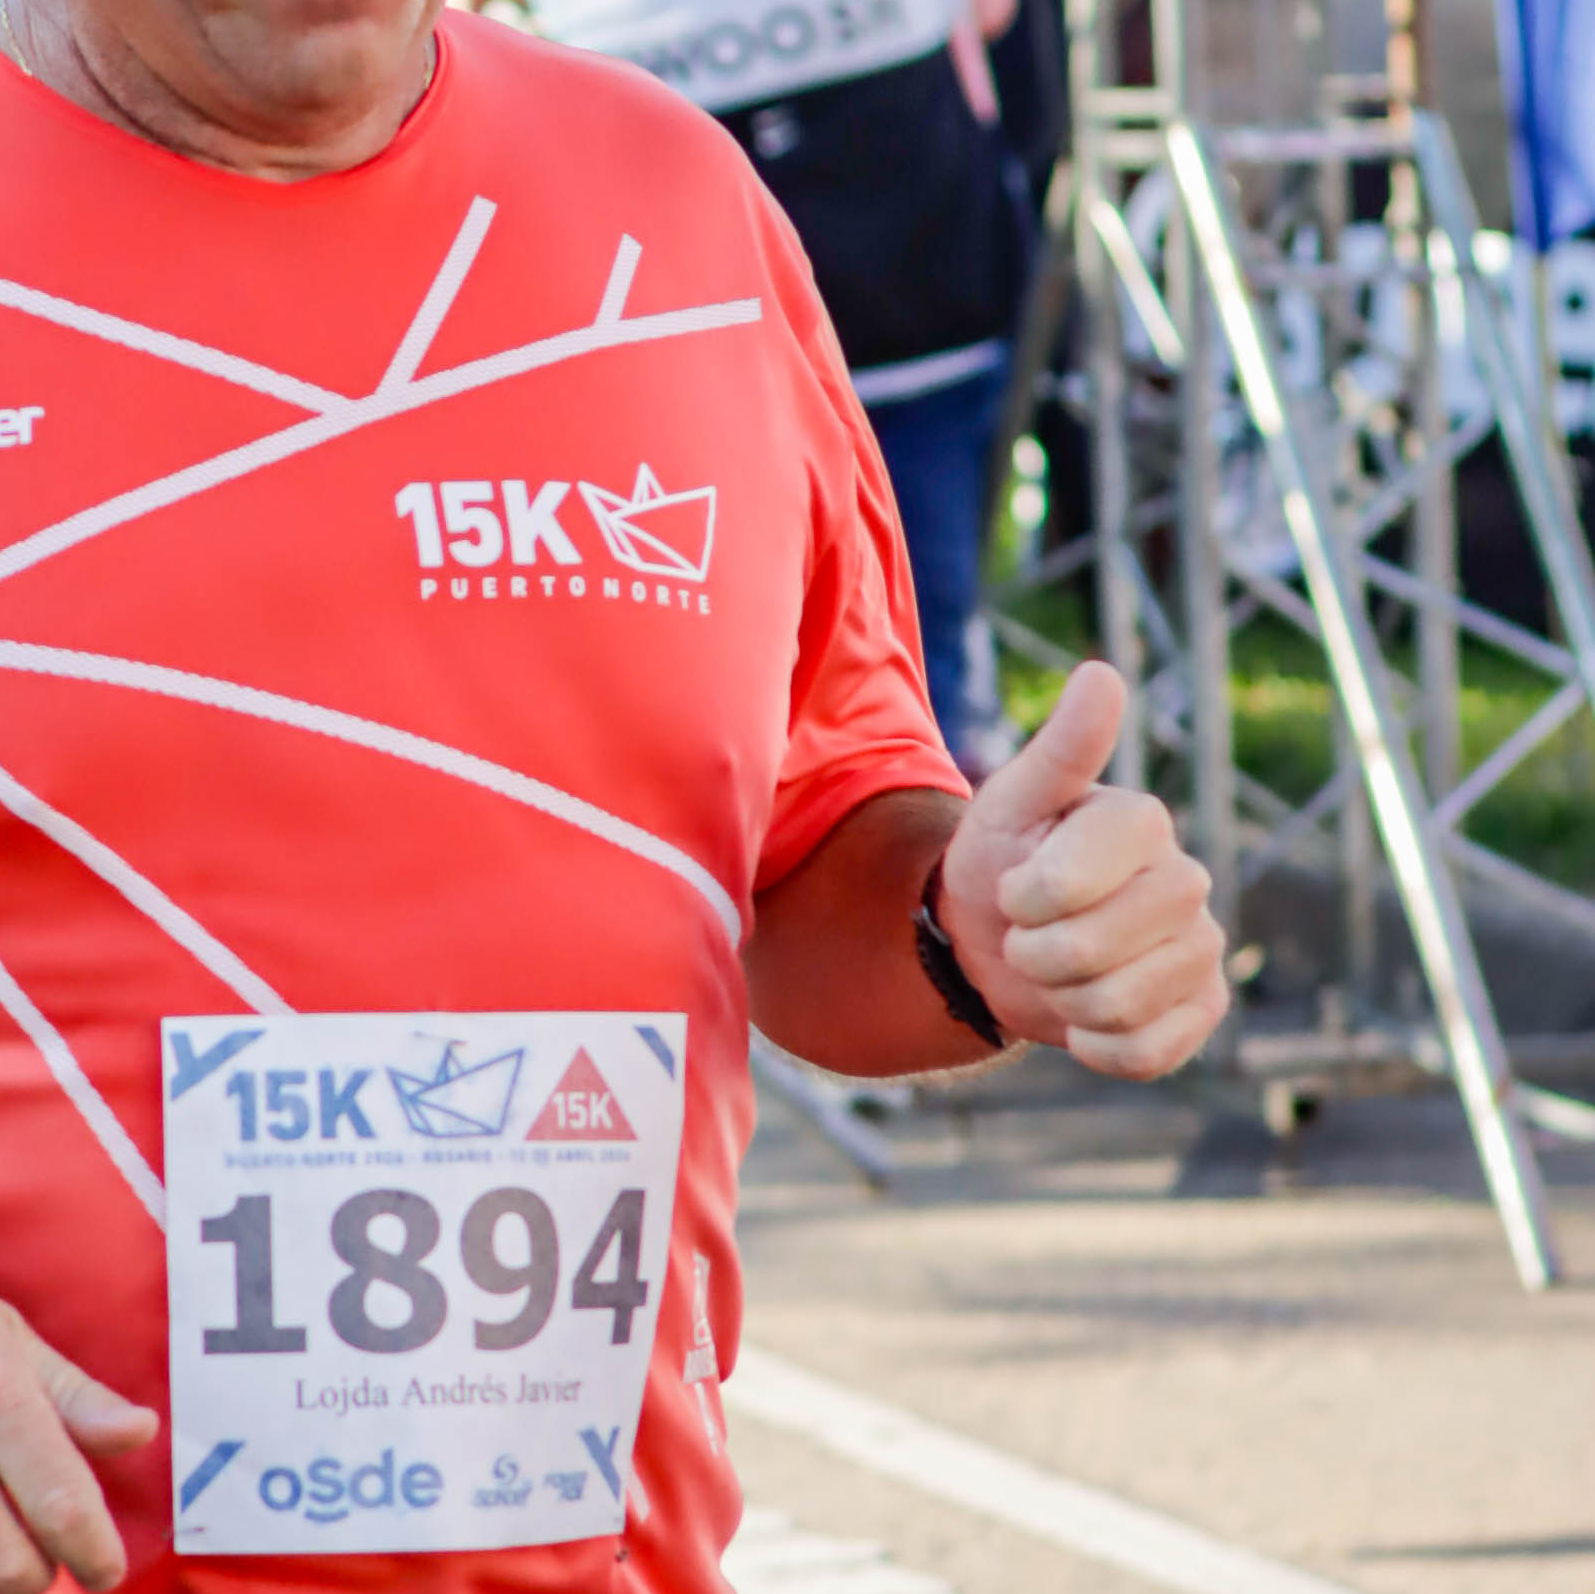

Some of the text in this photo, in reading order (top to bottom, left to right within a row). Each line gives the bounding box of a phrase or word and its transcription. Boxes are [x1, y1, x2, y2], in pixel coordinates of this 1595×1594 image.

[394, 479, 583, 568] 15K
[420, 575, 711, 615] PUERTO NORTE
[225, 1068, 377, 1142] 15K
[552, 1091, 614, 1130] 15K
[200, 1186, 648, 1355] 1894
[295, 1369, 583, 1418] Lojda Andrés Javier
[258, 1448, 443, 1517] osde
